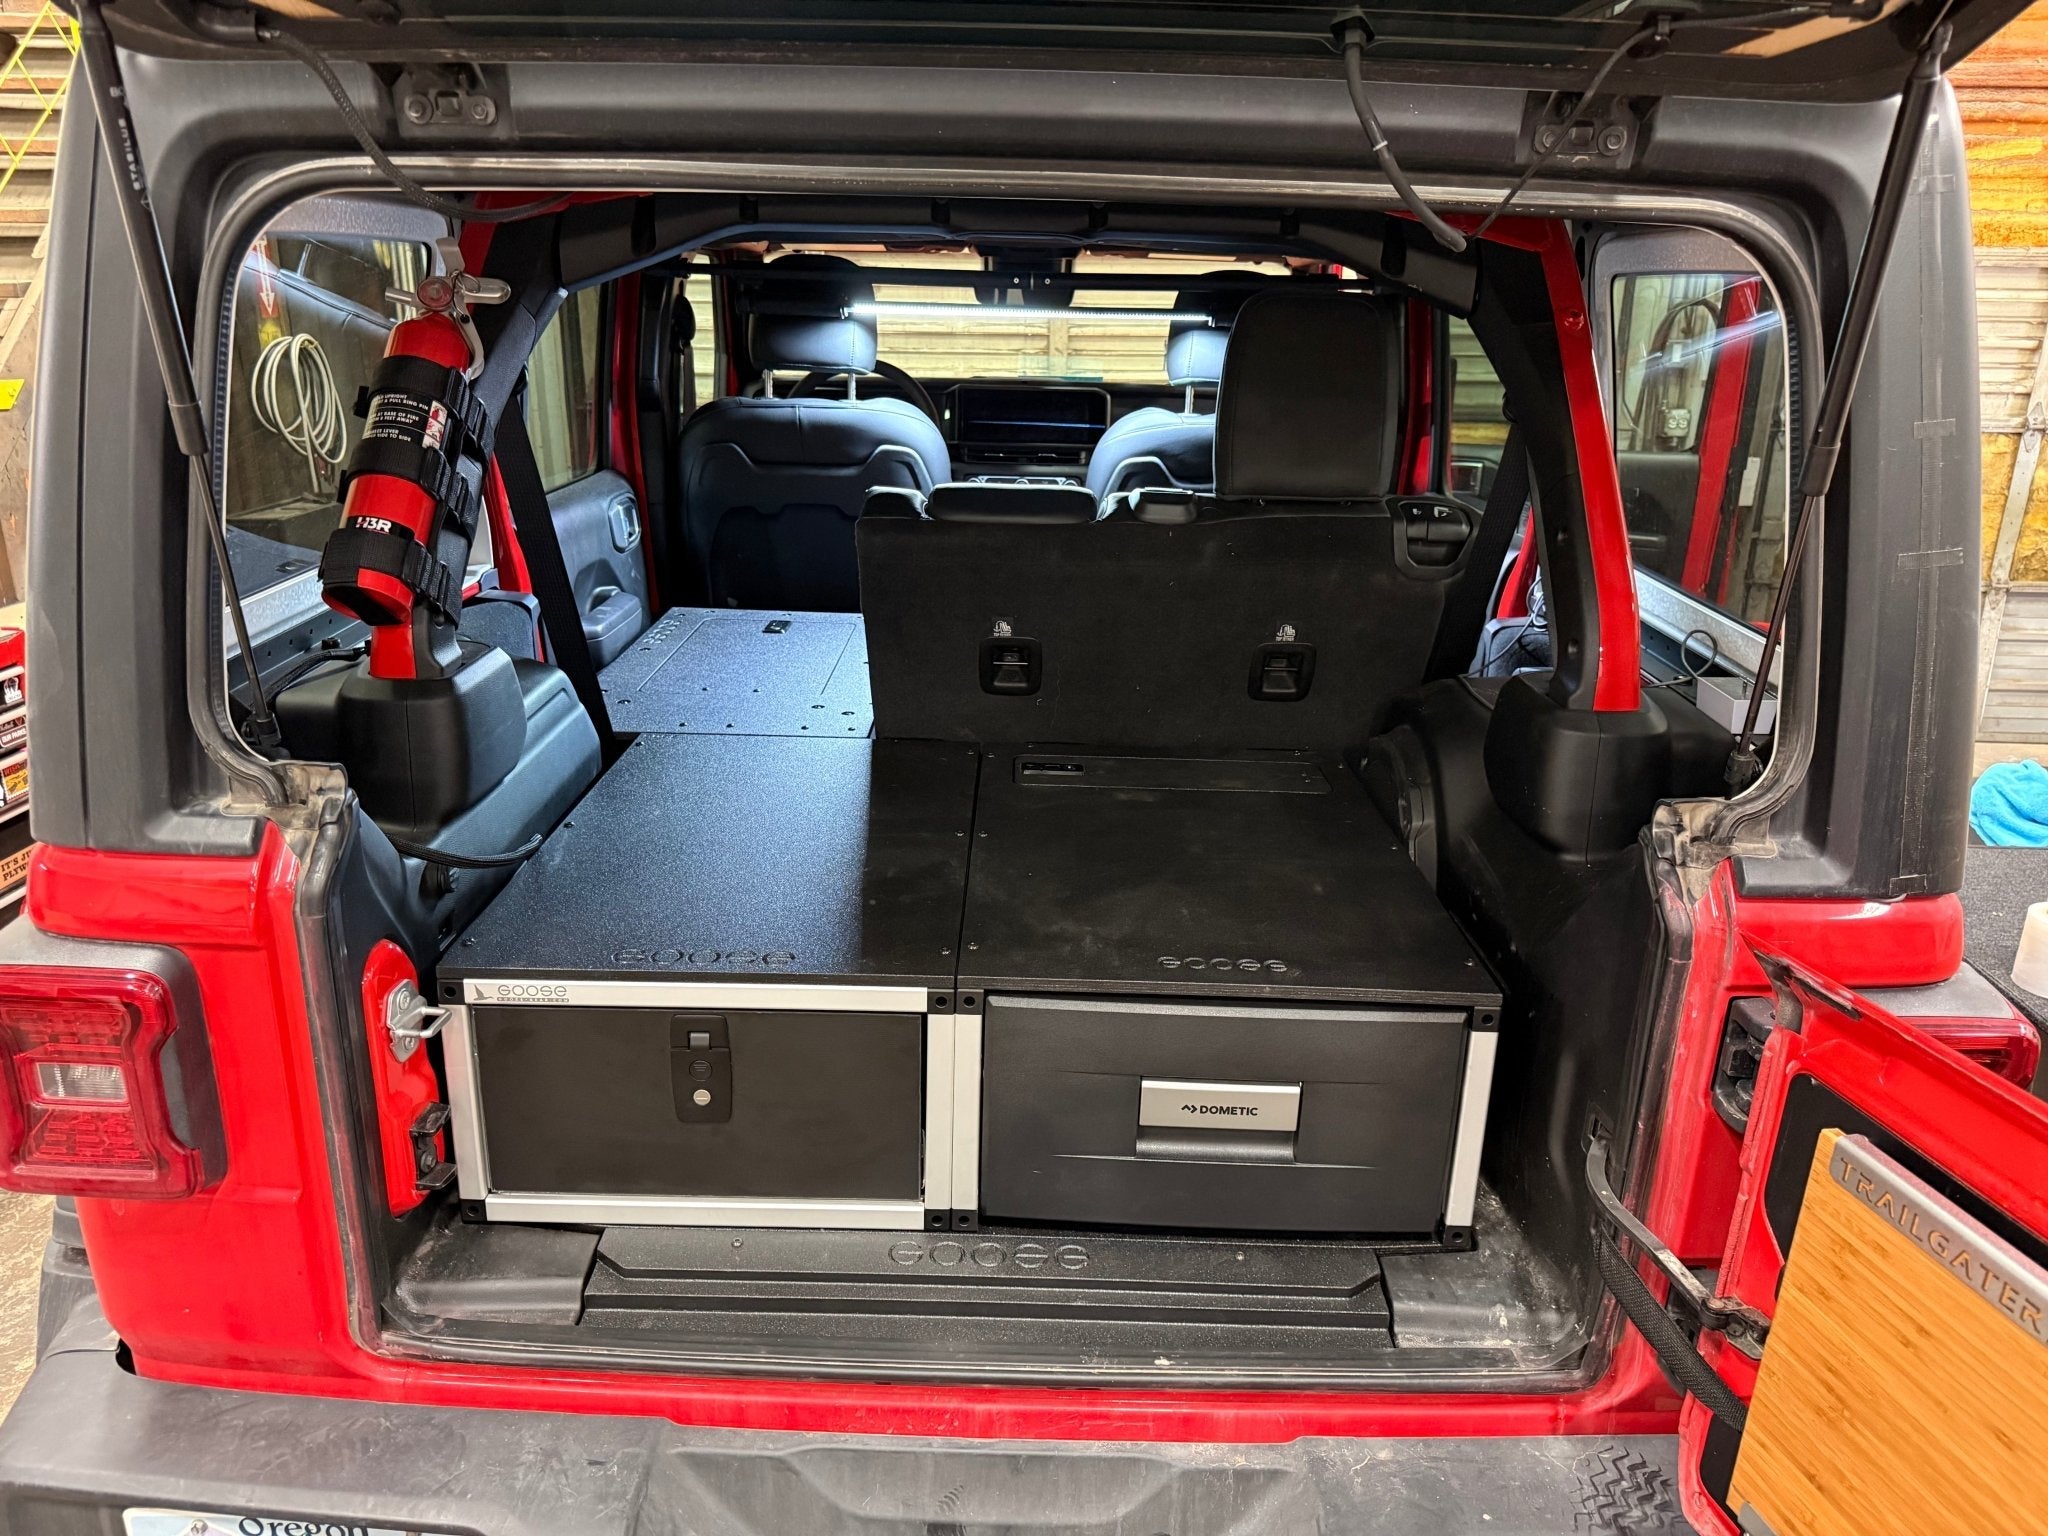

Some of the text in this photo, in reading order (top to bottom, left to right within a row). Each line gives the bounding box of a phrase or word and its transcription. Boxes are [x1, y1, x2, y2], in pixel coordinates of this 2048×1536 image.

[118, 118, 141, 191] STABILUS
[355, 516, 392, 533] H3R
[1, 857, 19, 872] IT'S
[1199, 1105, 1259, 1116] DOMETIC
[1839, 1156, 2045, 1335] TRAILGATER
